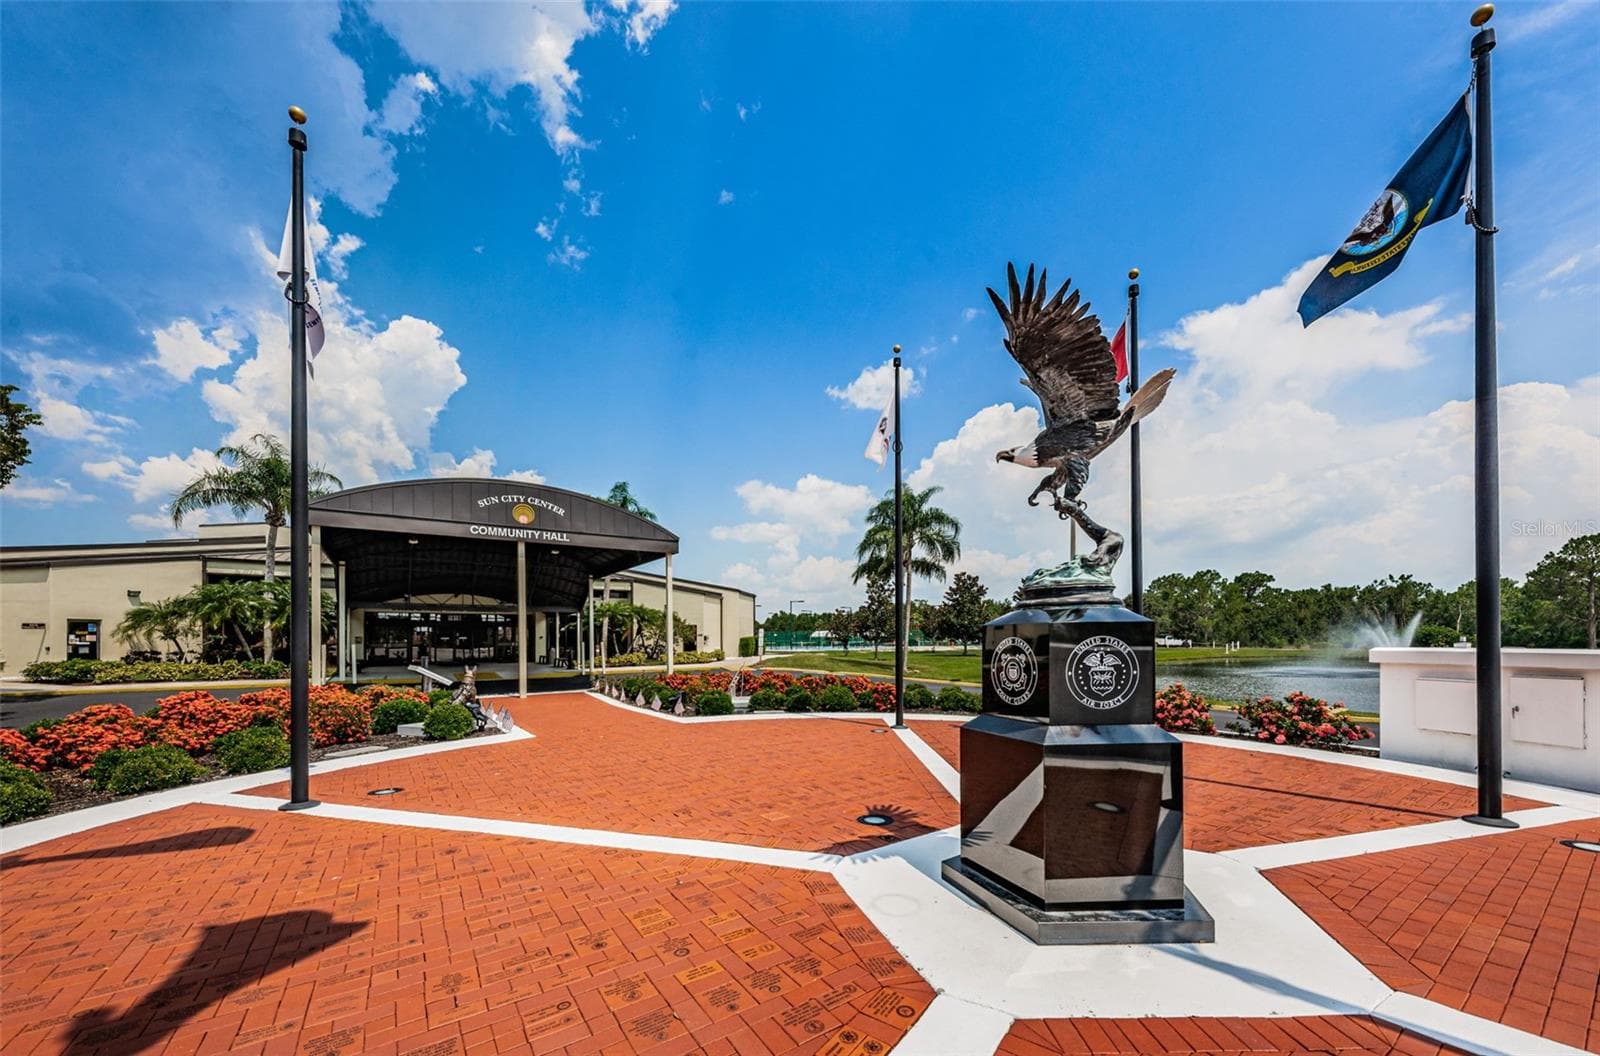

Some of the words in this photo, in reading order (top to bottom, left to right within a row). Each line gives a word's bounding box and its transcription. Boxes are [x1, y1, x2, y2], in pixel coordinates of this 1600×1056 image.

[477, 495, 499, 508] SUN
[501, 494, 526, 503] CITY
[527, 496, 566, 517] CENTER
[469, 525, 541, 540] COMMUNITY
[542, 532, 570, 542] HALL
[1075, 637, 1101, 654] UNITED
[1105, 637, 1130, 654] STATES
[1081, 697, 1096, 709] AIR
[1100, 696, 1124, 709] FORCE
